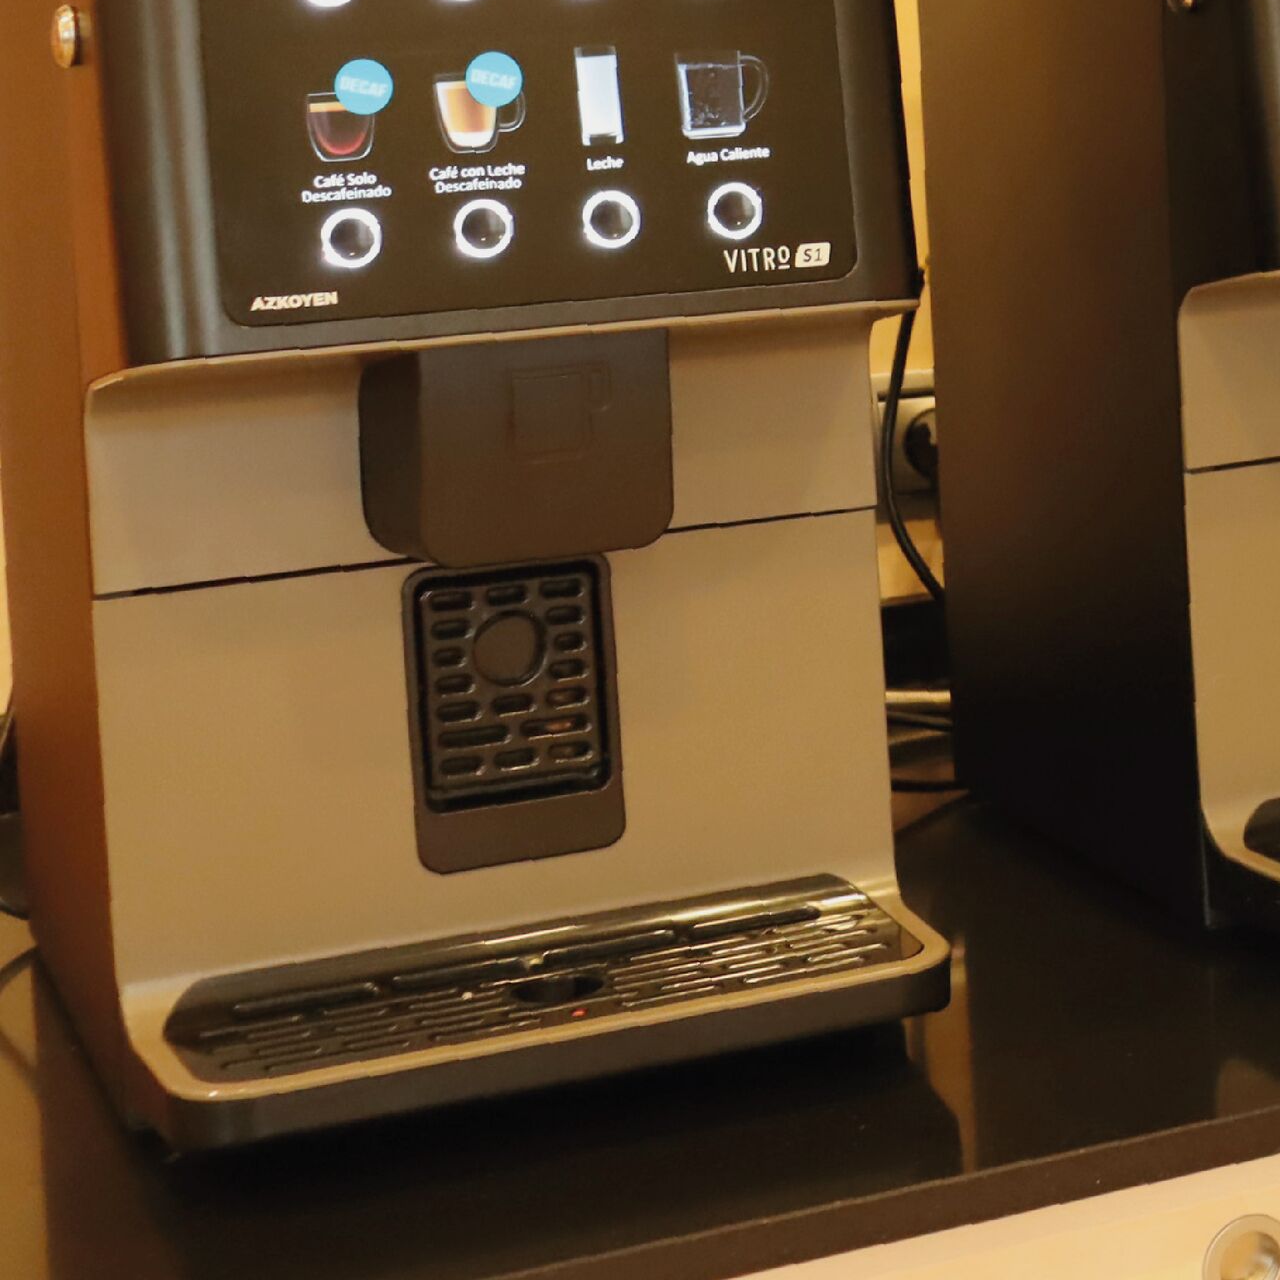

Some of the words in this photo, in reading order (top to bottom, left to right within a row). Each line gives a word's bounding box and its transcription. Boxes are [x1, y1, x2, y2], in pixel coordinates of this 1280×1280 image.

[340, 76, 388, 98] DECAF
[471, 68, 518, 90] DECAF
[587, 156, 624, 171] Leche
[687, 150, 719, 166] Agua
[720, 146, 771, 161] Caliente
[313, 173, 345, 189] Café
[347, 172, 377, 186] Solo
[429, 166, 458, 181] Café
[461, 165, 485, 178] con
[487, 163, 526, 177] Leche
[301, 185, 392, 203] Descafeinado
[434, 177, 522, 194] Descafeinado
[723, 245, 791, 273] VITRO
[802, 247, 823, 262] S1
[250, 291, 339, 311] AZKOYEN
